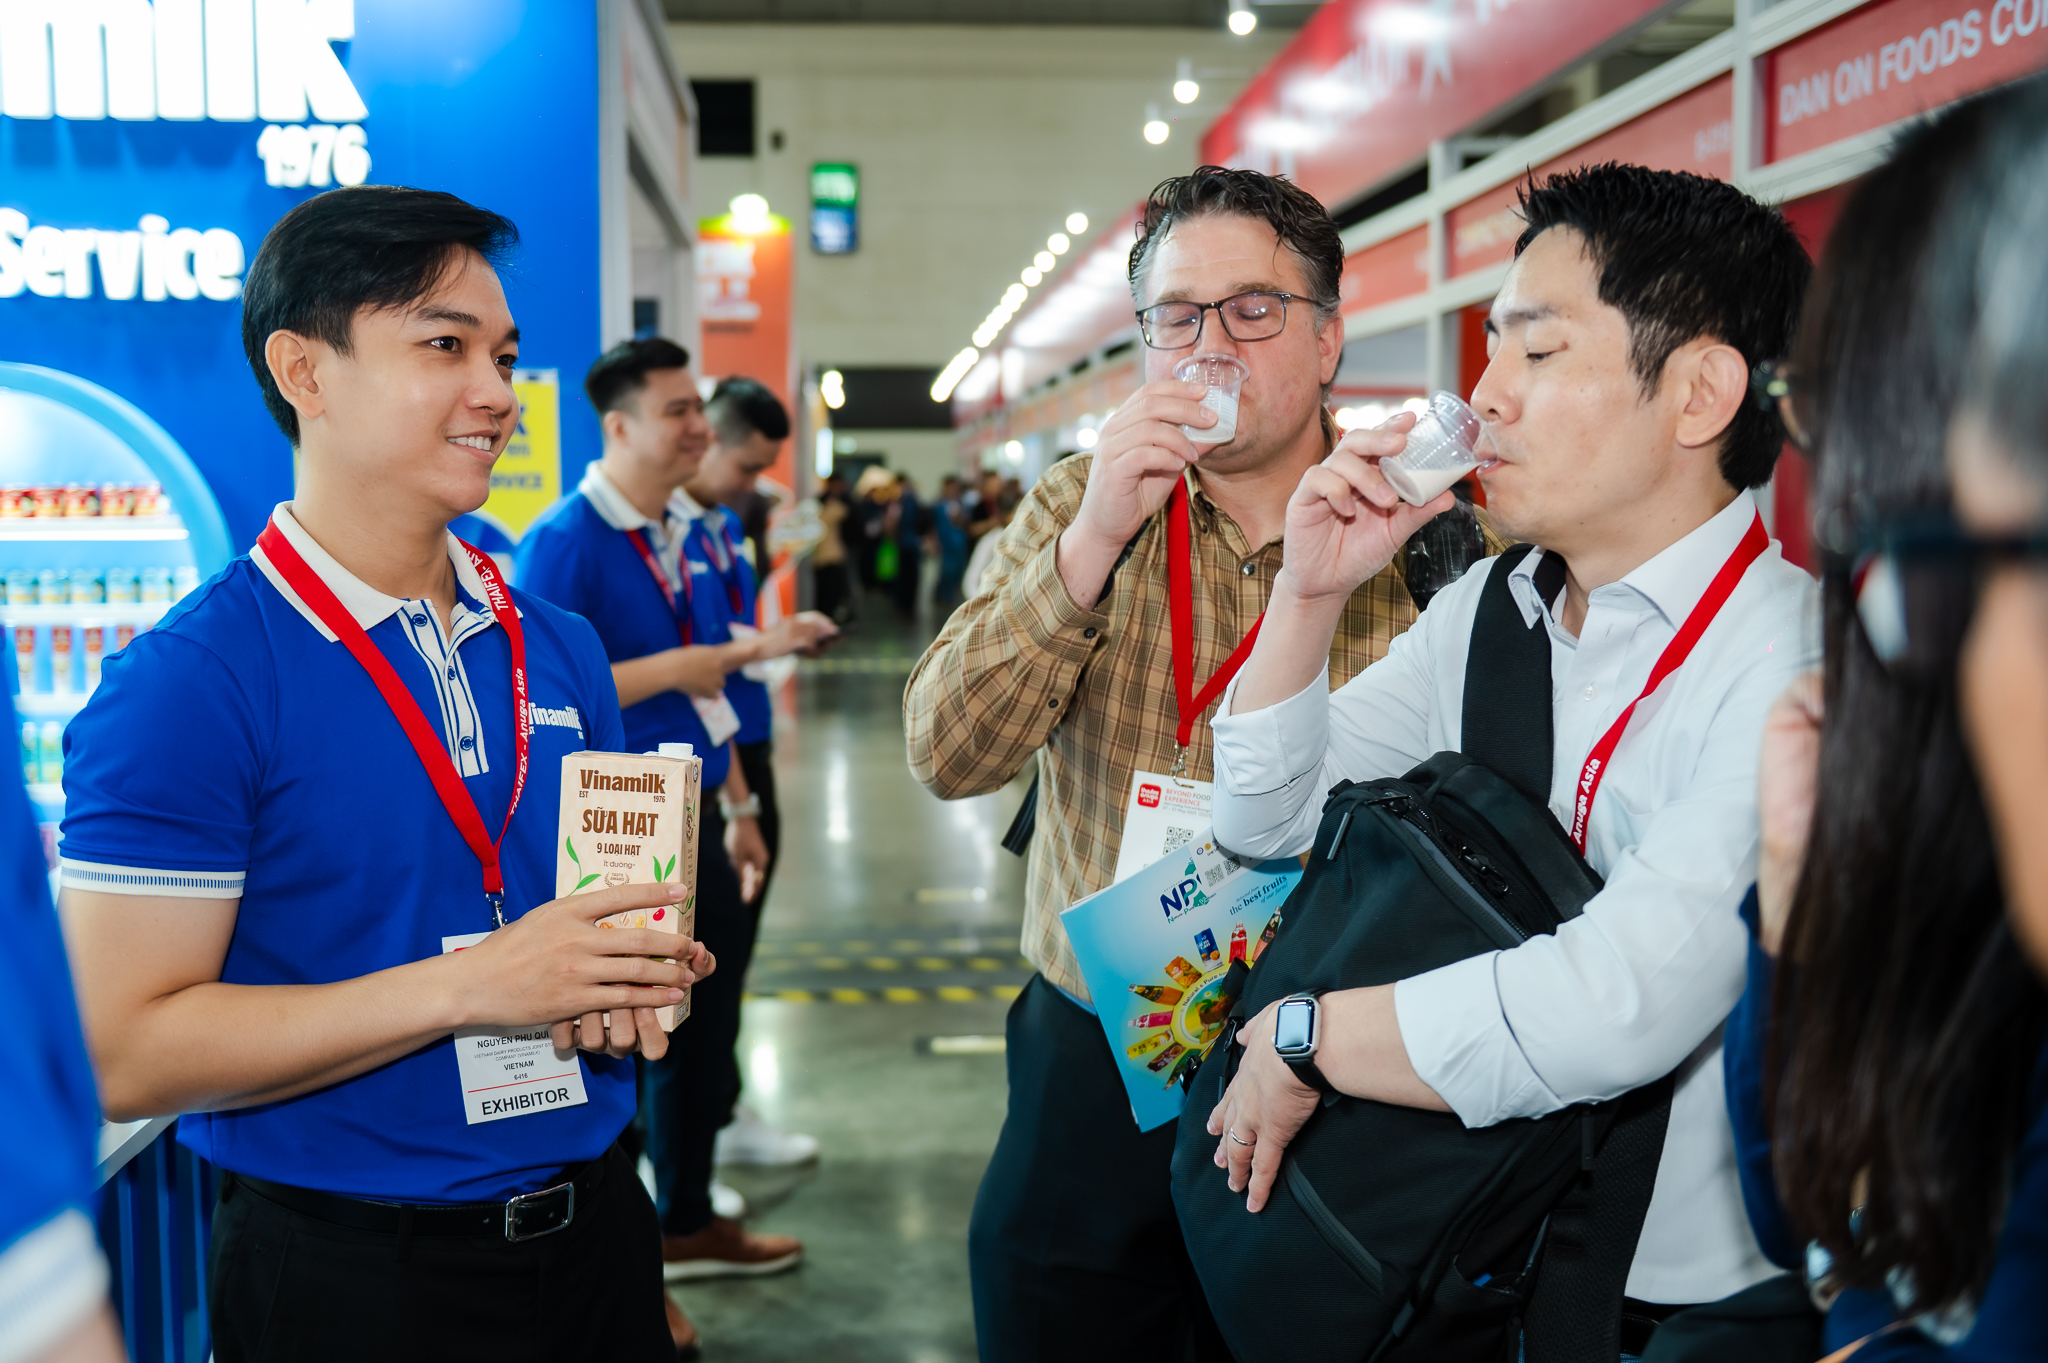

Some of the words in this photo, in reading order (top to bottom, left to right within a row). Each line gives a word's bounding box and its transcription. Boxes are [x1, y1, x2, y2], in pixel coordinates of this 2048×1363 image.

[1779, 69, 1830, 126] DAN
[1833, 53, 1873, 106] ON
[1878, 9, 1983, 90] FOODS
[257, 123, 372, 188] 1976
[515, 667, 526, 697] Asia
[519, 698, 529, 743] Anuga
[509, 752, 528, 816] THAIFEX
[580, 769, 666, 794] Vinamilk
[1580, 758, 1601, 794] Asia
[579, 790, 589, 798] EST
[653, 795, 666, 803] 1976
[1165, 795, 1201, 806] EXPERIENCE
[1166, 788, 1192, 797] BEYOND
[1193, 792, 1211, 801] FOOD
[582, 806, 617, 834] SỮA
[622, 811, 659, 838] HẠT
[1573, 794, 1588, 845] Anuga
[596, 842, 603, 854] 9
[1160, 873, 1202, 917] NP
[1229, 903, 1243, 915] the
[1243, 891, 1262, 907] best
[1262, 875, 1287, 894] fruits
[1182, 986, 1200, 1006] Natural
[1203, 975, 1218, 985] Pure
[477, 1036, 513, 1048] NGUYEN
[514, 1033, 532, 1043] PHU
[534, 1031, 549, 1040] QUI
[504, 1060, 534, 1070] VIETNAM
[481, 1088, 570, 1115] EXHIBITOR
